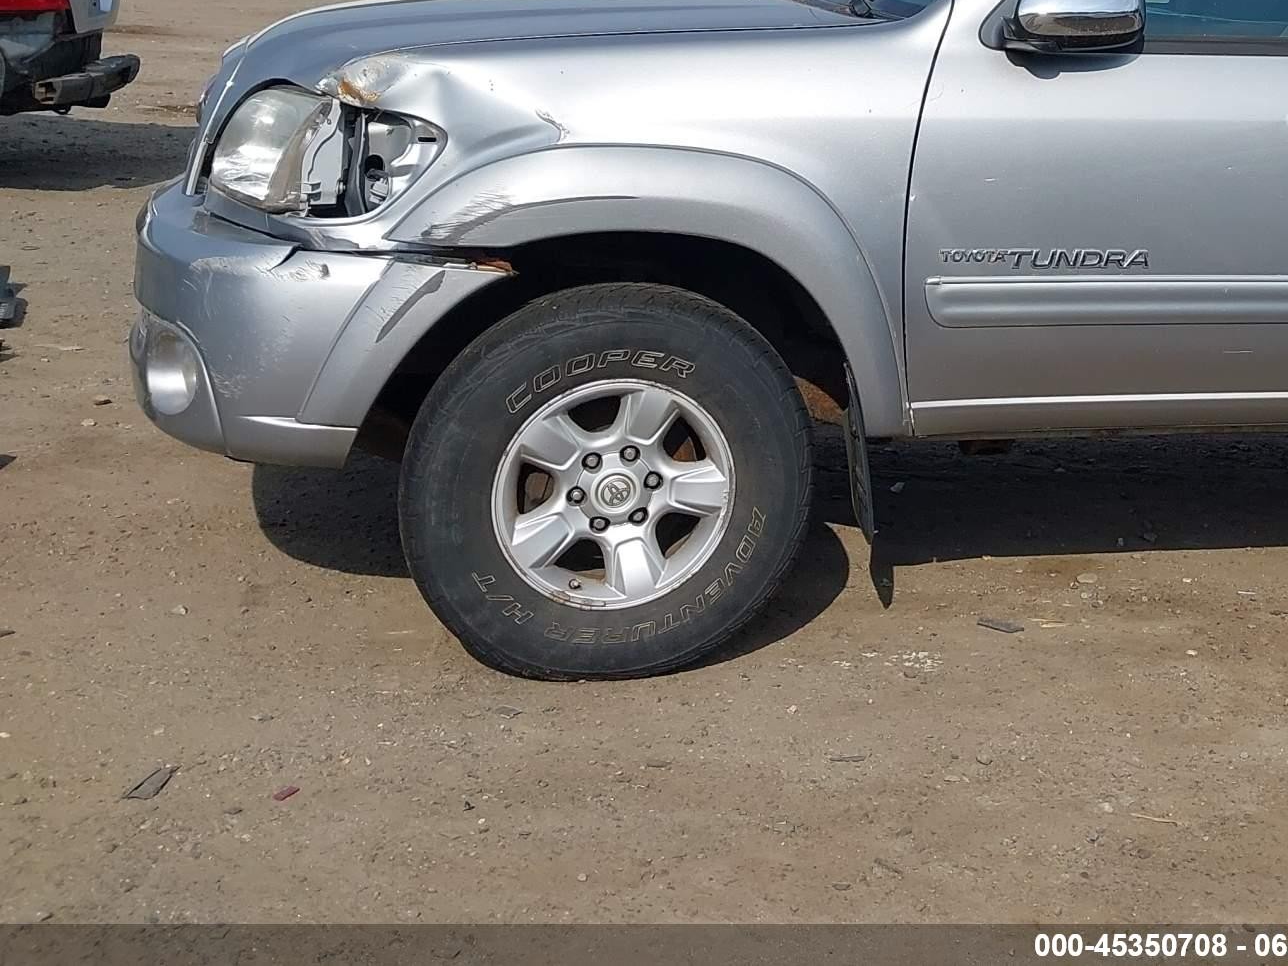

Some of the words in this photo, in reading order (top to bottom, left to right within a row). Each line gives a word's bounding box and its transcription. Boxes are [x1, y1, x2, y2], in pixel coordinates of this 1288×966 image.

[938, 248, 1008, 263] TOYOTA
[1007, 248, 1150, 270] TUNDRA
[503, 348, 697, 416] COOPER
[471, 570, 535, 625] H/T
[543, 505, 767, 645] ADVENTURER
